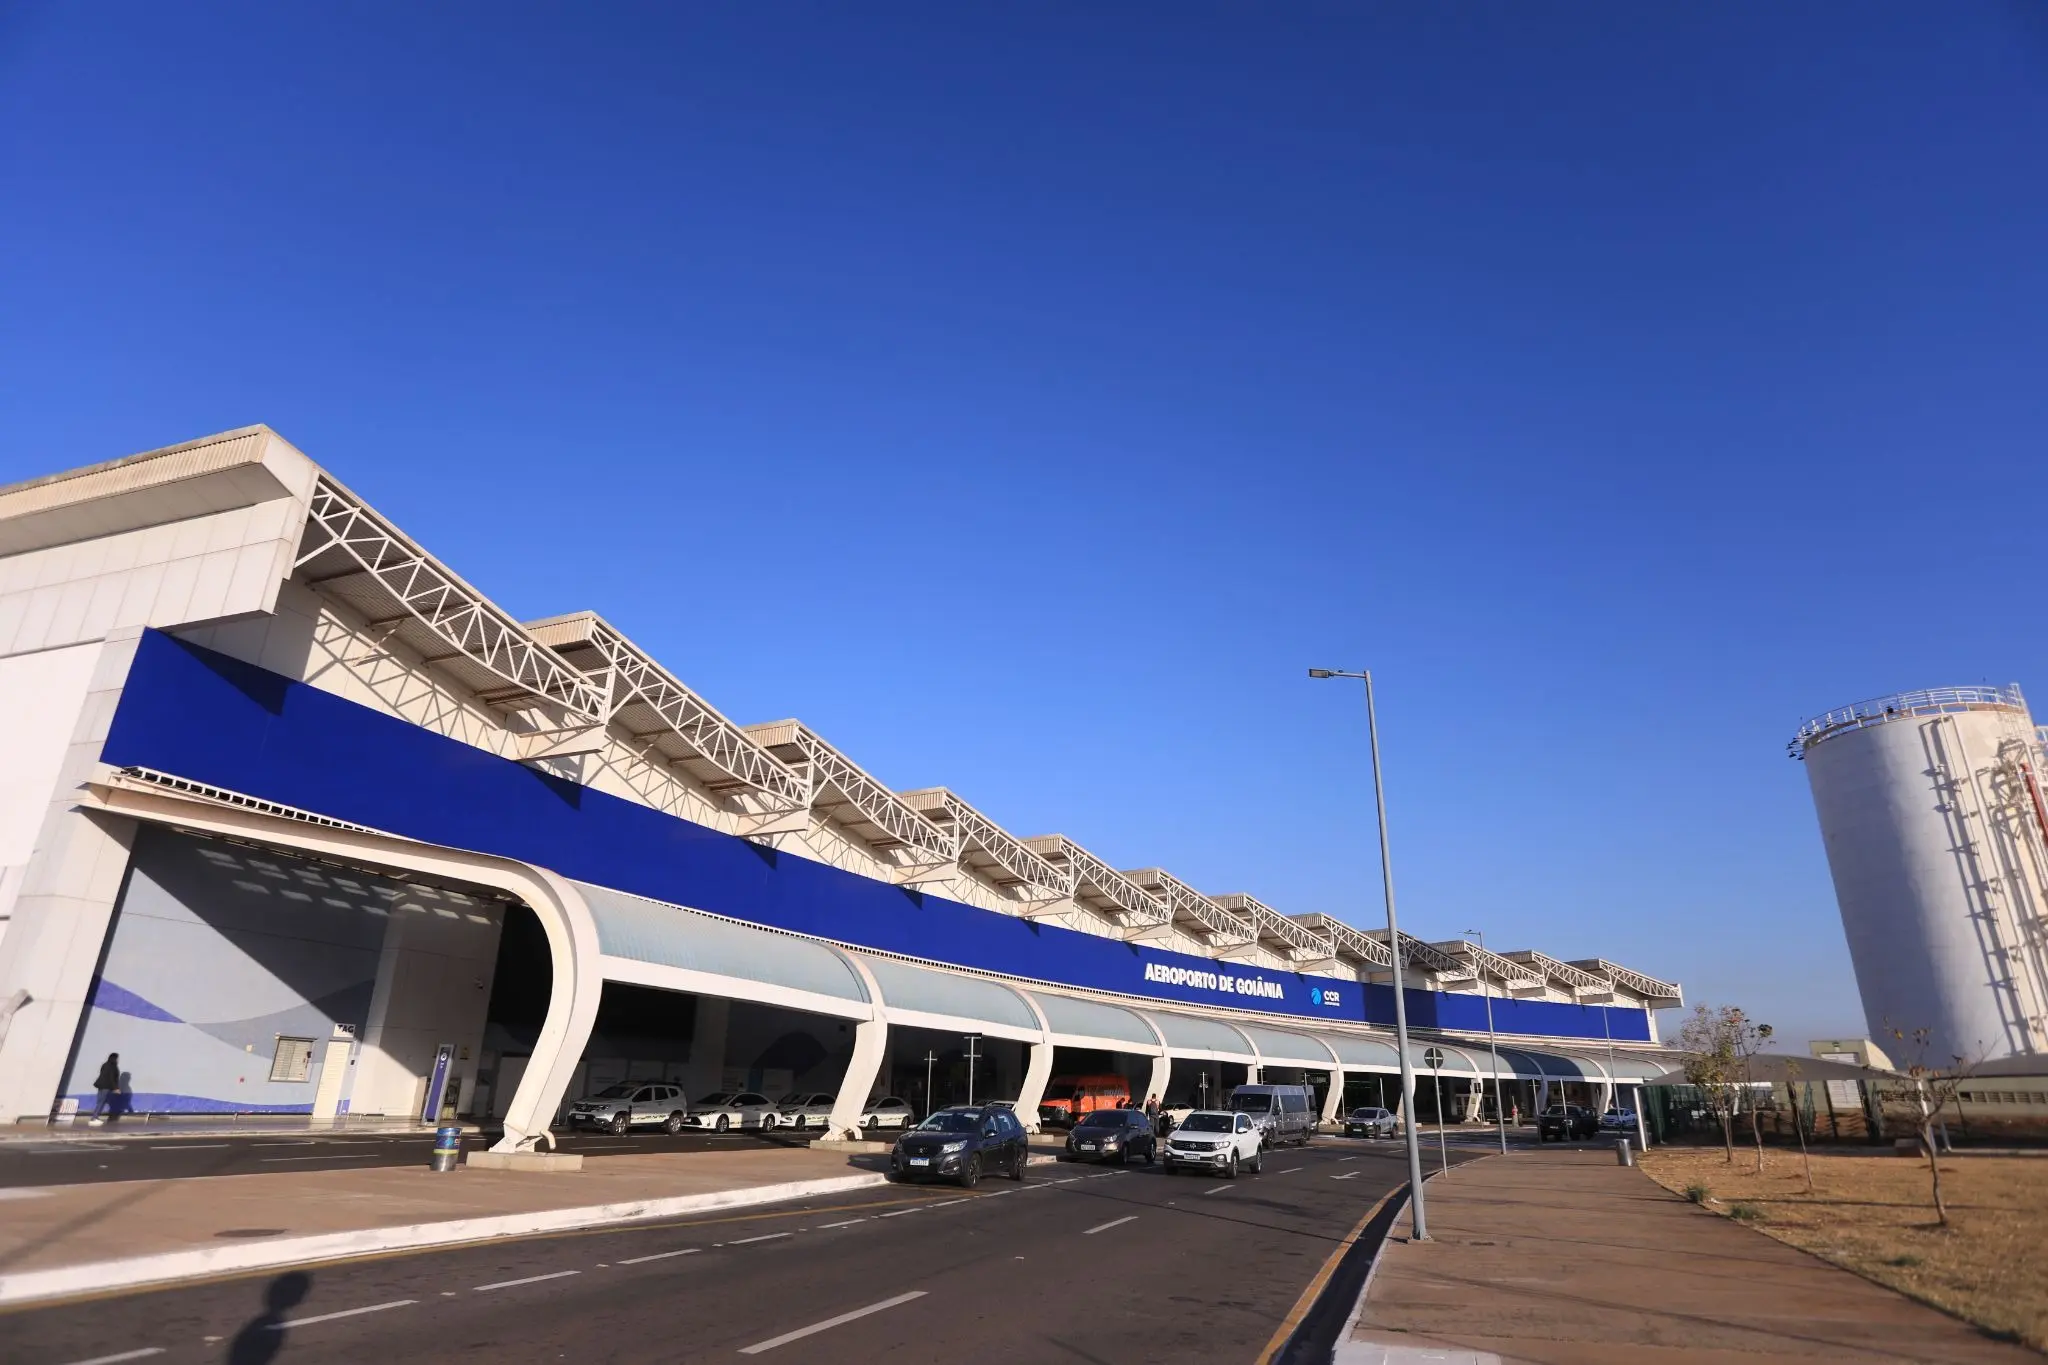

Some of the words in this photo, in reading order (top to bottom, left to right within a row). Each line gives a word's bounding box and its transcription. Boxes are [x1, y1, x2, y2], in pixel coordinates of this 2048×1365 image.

[1145, 963, 1216, 989] AEROPORTO
[1219, 975, 1234, 993] DE
[1236, 976, 1284, 999] GOIÂNIA
[1324, 990, 1340, 1001] CCR
